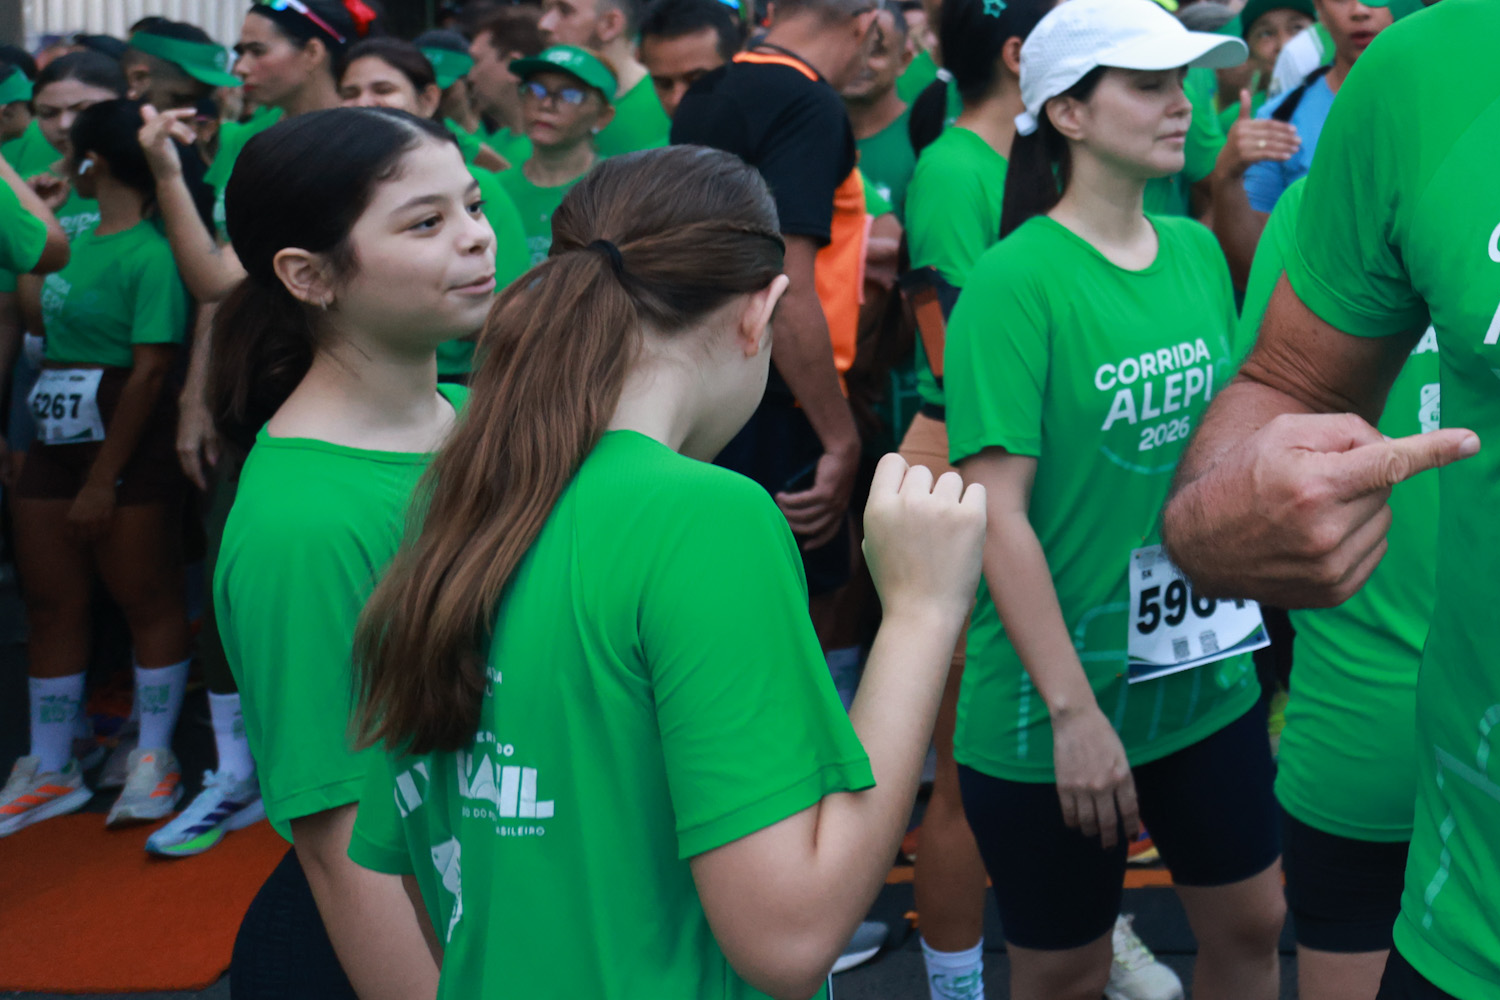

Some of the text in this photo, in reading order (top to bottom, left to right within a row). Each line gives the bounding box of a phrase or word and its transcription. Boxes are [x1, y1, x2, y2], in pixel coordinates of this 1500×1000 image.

[1094, 337, 1211, 391] CORRIDA
[1101, 364, 1214, 431] ALEPI
[1138, 415, 1191, 451] 2026
[1136, 579, 1245, 636] 59
